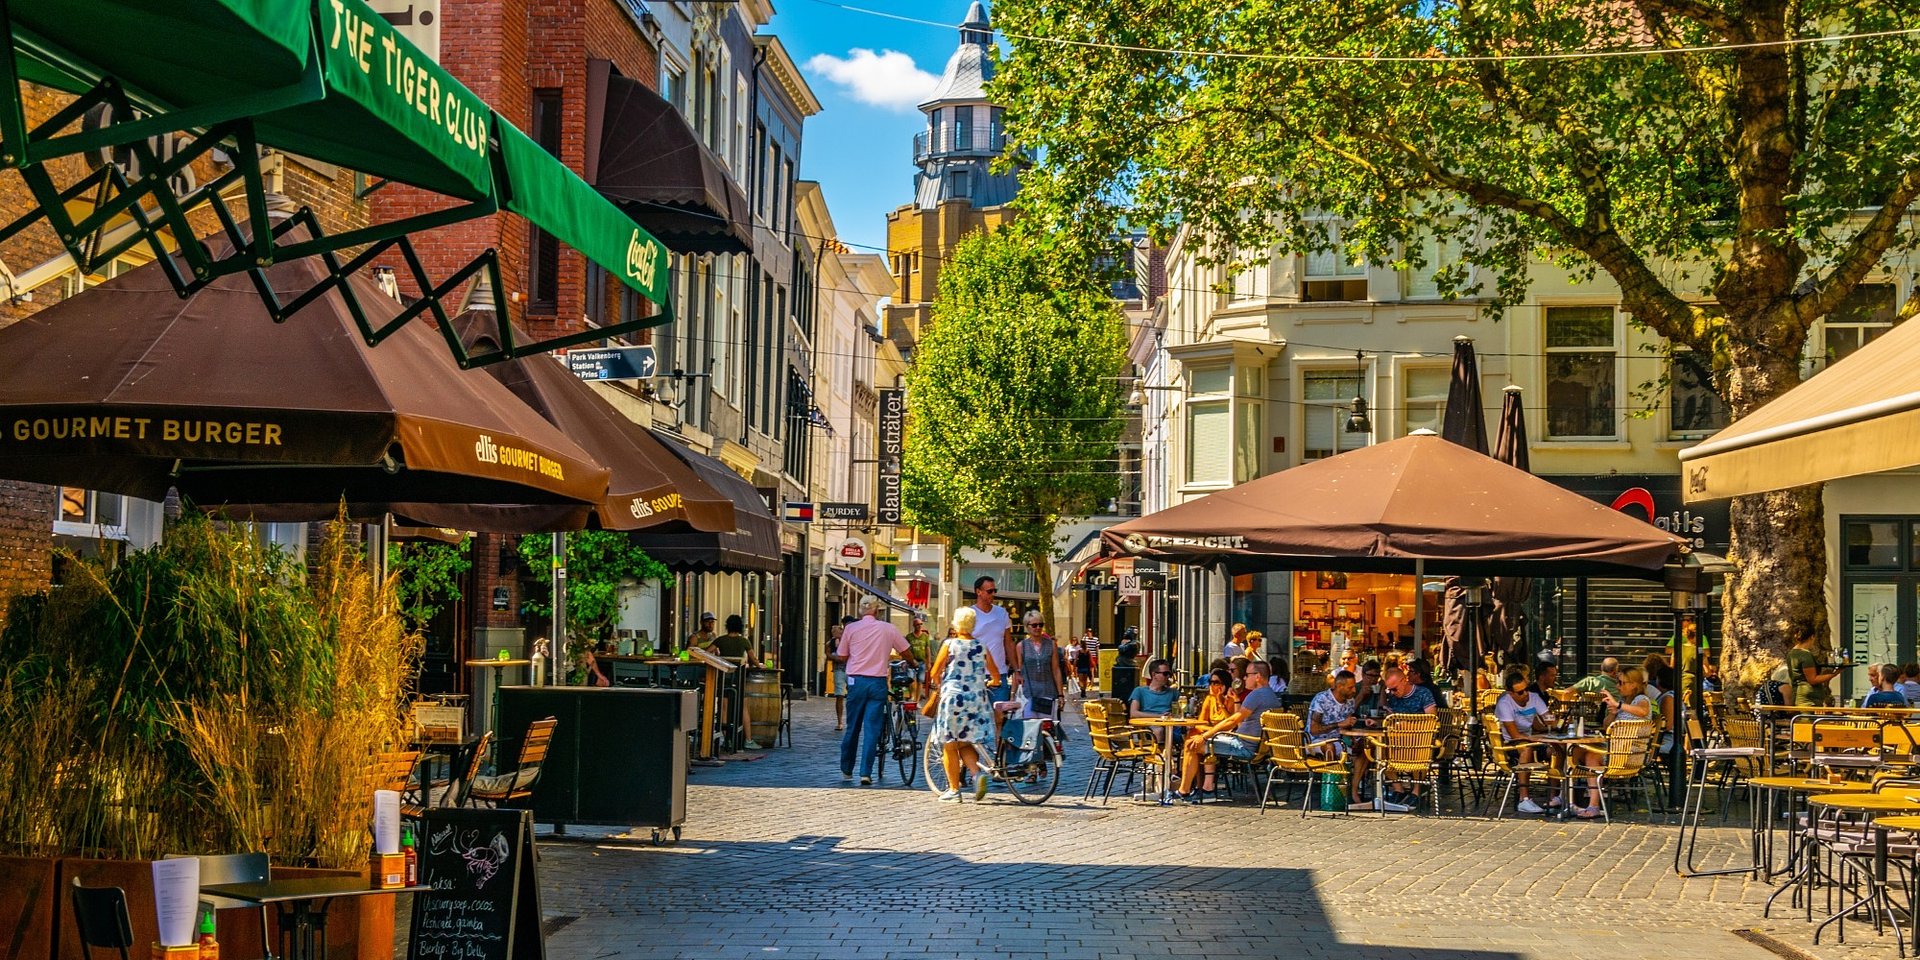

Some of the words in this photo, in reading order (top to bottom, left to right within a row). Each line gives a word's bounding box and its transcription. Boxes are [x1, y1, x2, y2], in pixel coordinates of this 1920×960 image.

[330, 0, 374, 74] THE
[382, 31, 441, 125] TIGER
[445, 91, 487, 158] CLUB
[571, 362, 595, 370] Station
[587, 352, 621, 360] Valkenberg
[581, 370, 599, 378] Prins
[13, 416, 151, 440] GOURMET
[162, 419, 282, 445] BURGER
[882, 392, 902, 455] sträter
[475, 434, 498, 464] ellis
[499, 445, 538, 473] GOURMET
[539, 455, 565, 481] BURGER
[630, 497, 654, 520] ellis
[452, 940, 464, 960] Big
